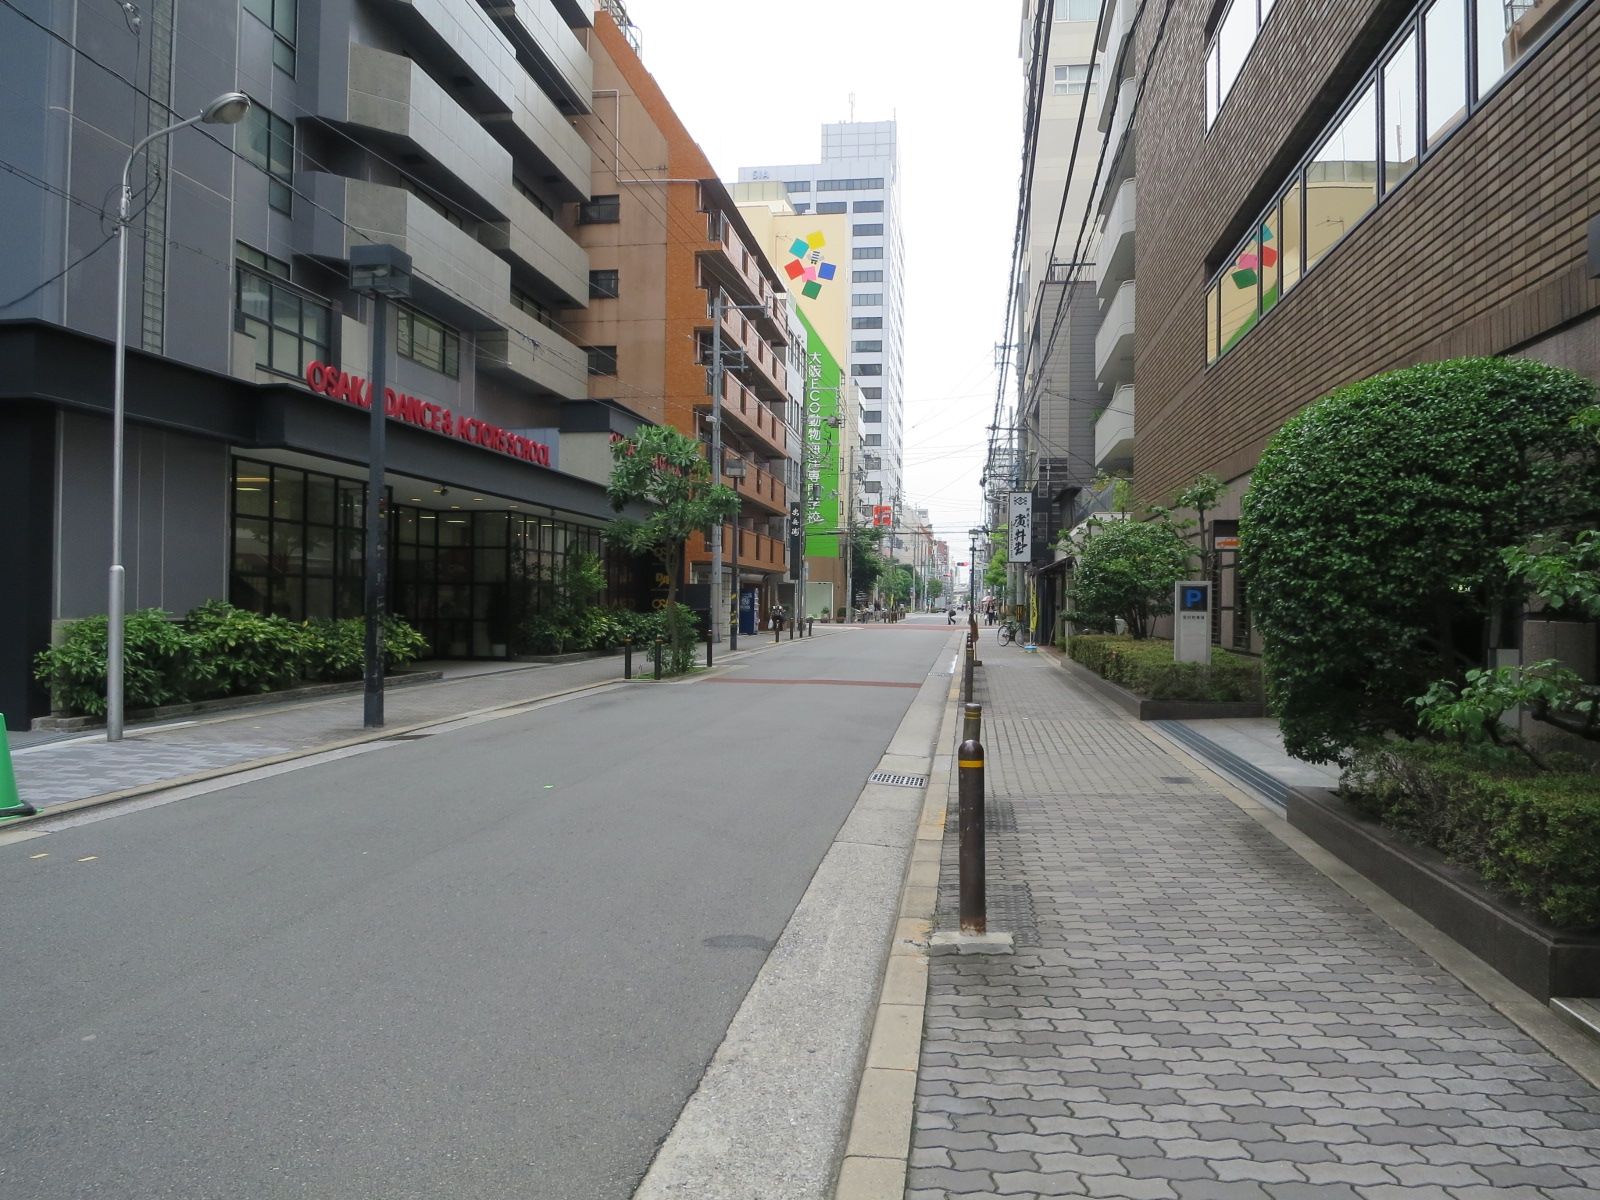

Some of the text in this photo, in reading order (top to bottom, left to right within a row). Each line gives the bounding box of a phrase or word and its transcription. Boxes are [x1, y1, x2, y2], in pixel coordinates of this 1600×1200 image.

[384, 387, 442, 431] DANCE
[441, 408, 453, 435] &
[455, 416, 508, 452] ACTORS
[507, 432, 551, 467] SCHOOL
[1185, 589, 1201, 608] P
